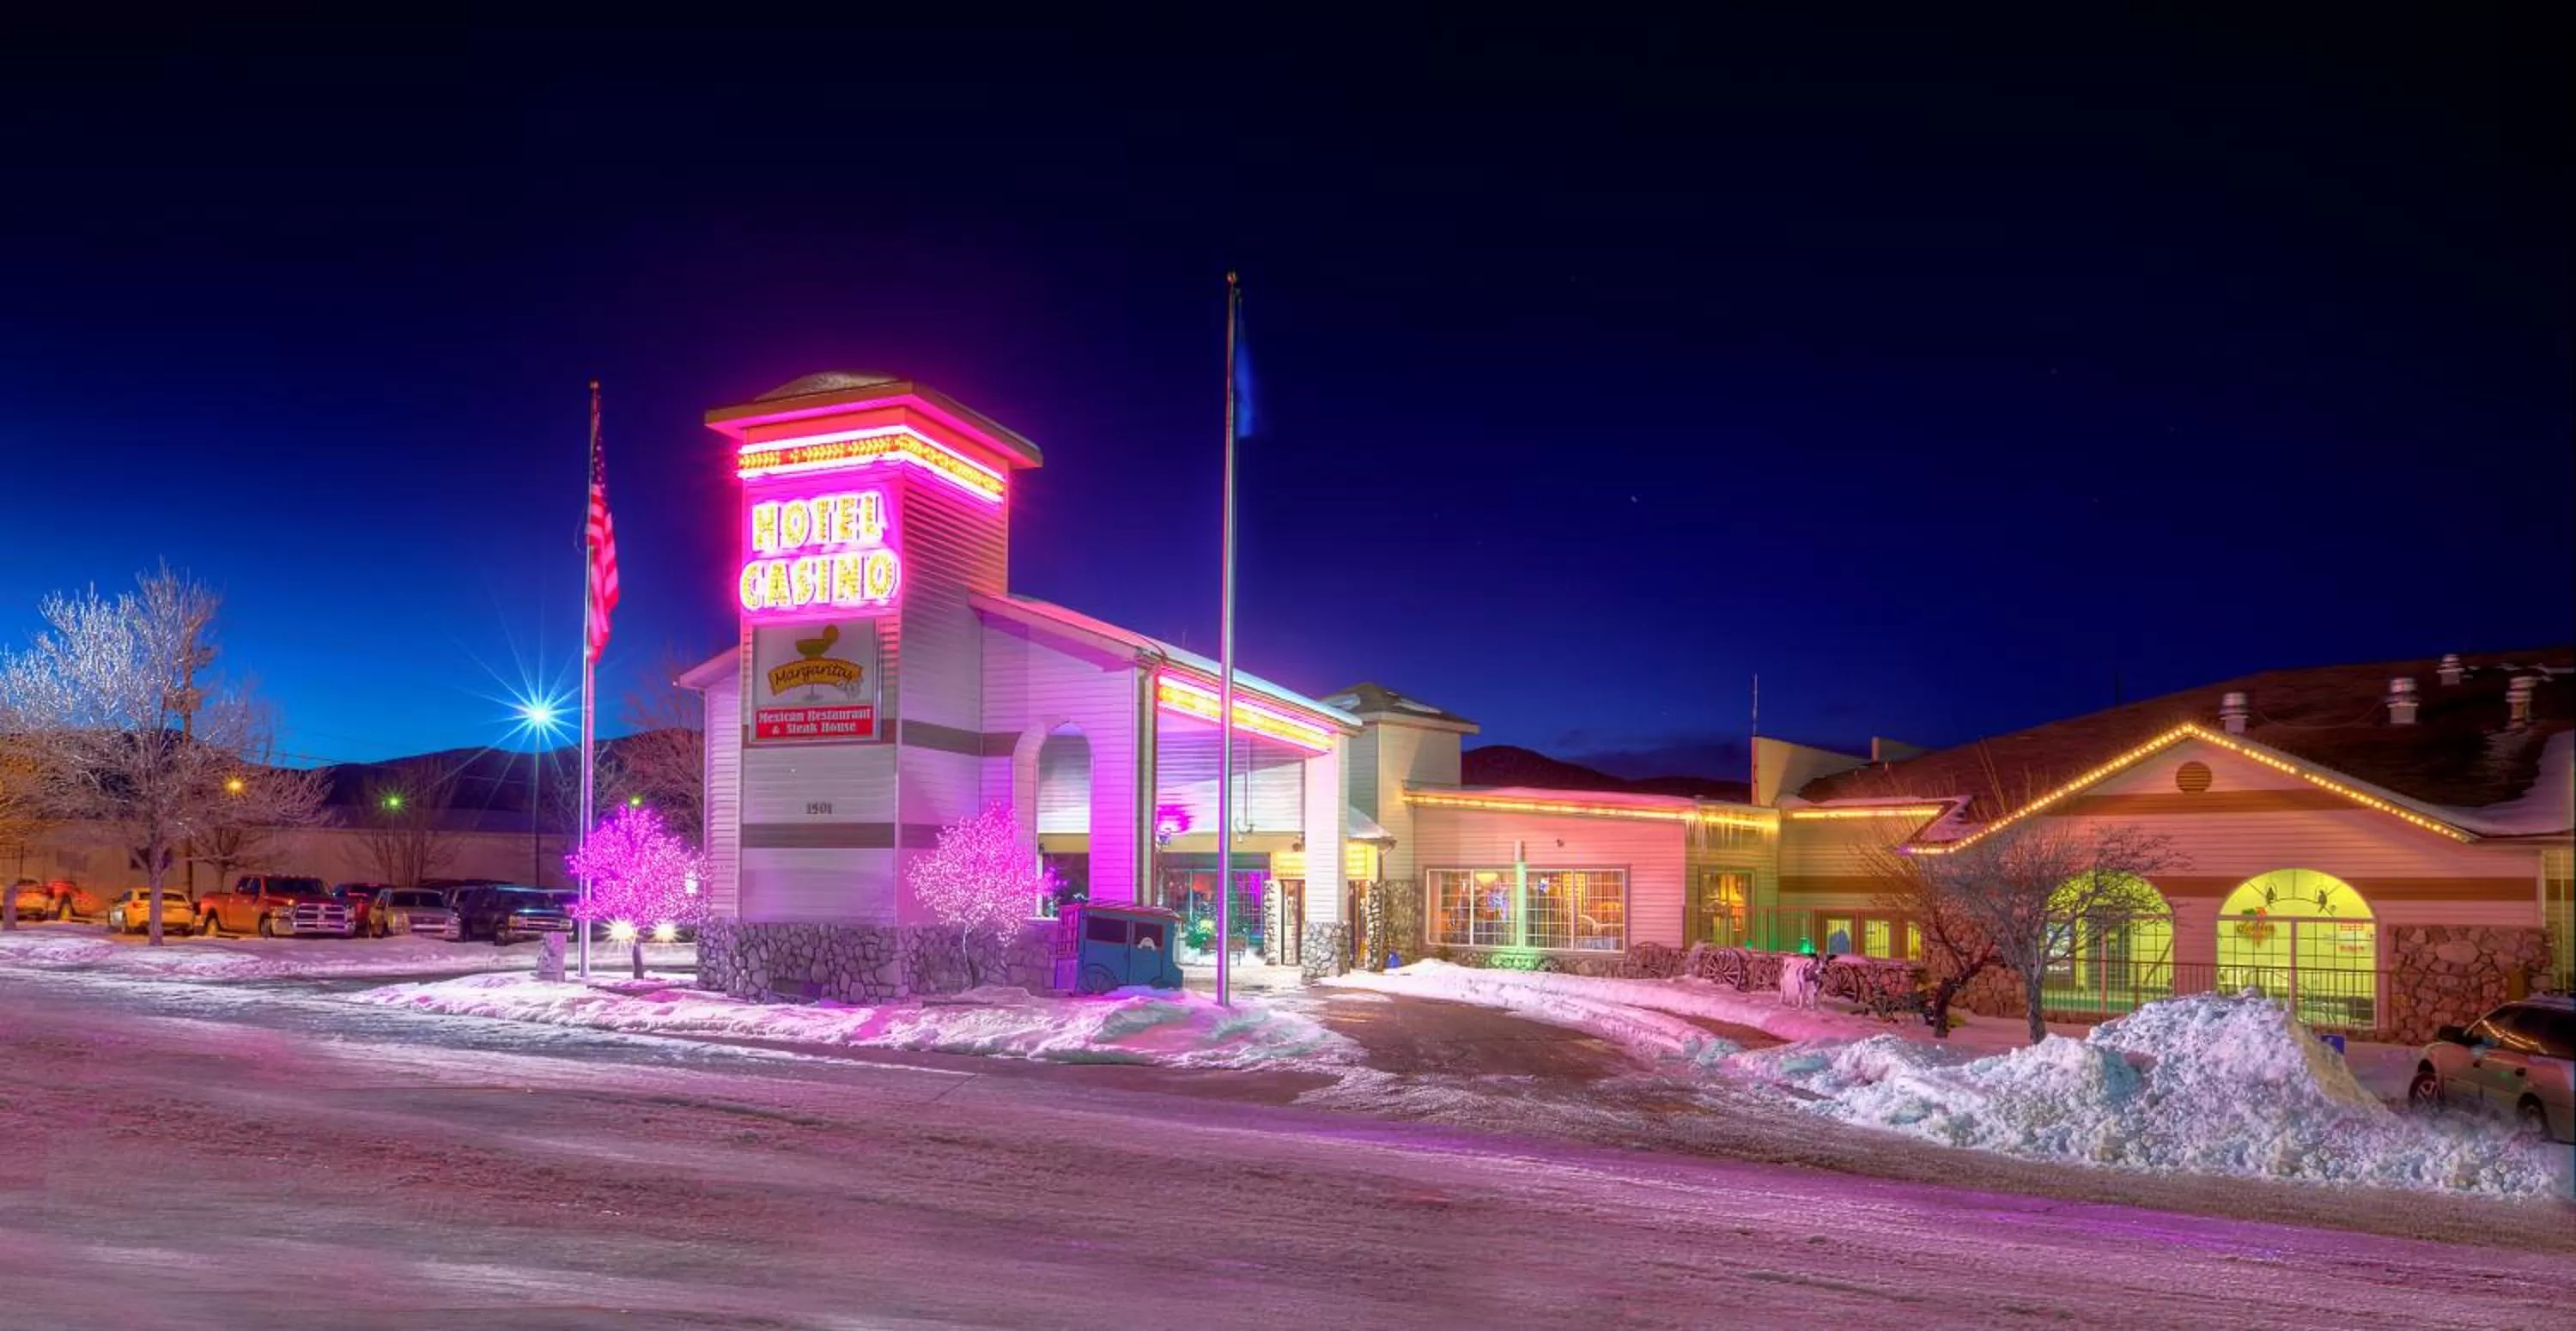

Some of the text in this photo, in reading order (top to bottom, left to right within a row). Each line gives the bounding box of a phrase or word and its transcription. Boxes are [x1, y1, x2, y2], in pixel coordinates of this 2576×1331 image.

[751, 493, 886, 552] HOTEL
[740, 550, 900, 610] CASINO
[775, 665, 853, 686] Margaritas
[758, 707, 871, 722] Mexican Restaurant
[772, 721, 856, 736] & Steak House
